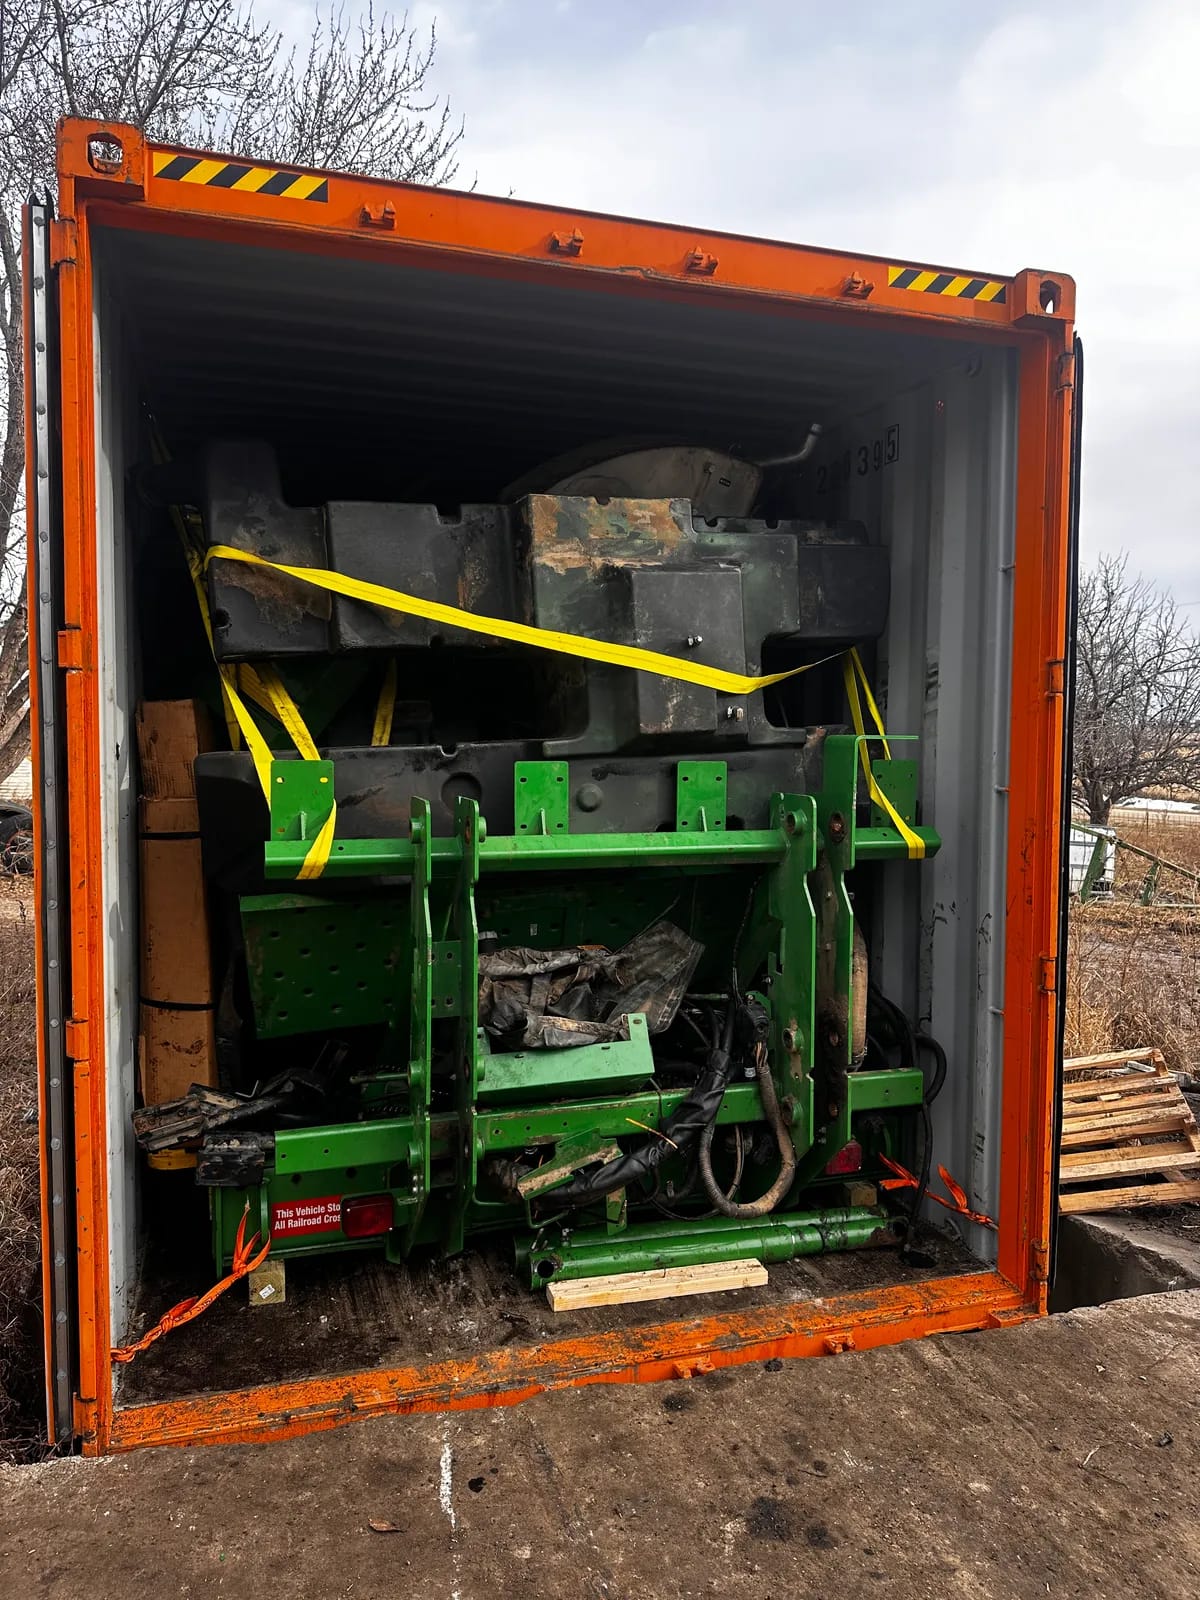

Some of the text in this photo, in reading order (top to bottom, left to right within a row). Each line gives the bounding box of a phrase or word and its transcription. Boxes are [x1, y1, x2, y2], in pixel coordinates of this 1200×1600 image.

[276, 1209, 293, 1218] This
[296, 1205, 325, 1216] Vehicle
[275, 1221, 285, 1230] All
[288, 1215, 321, 1228] Railroad
